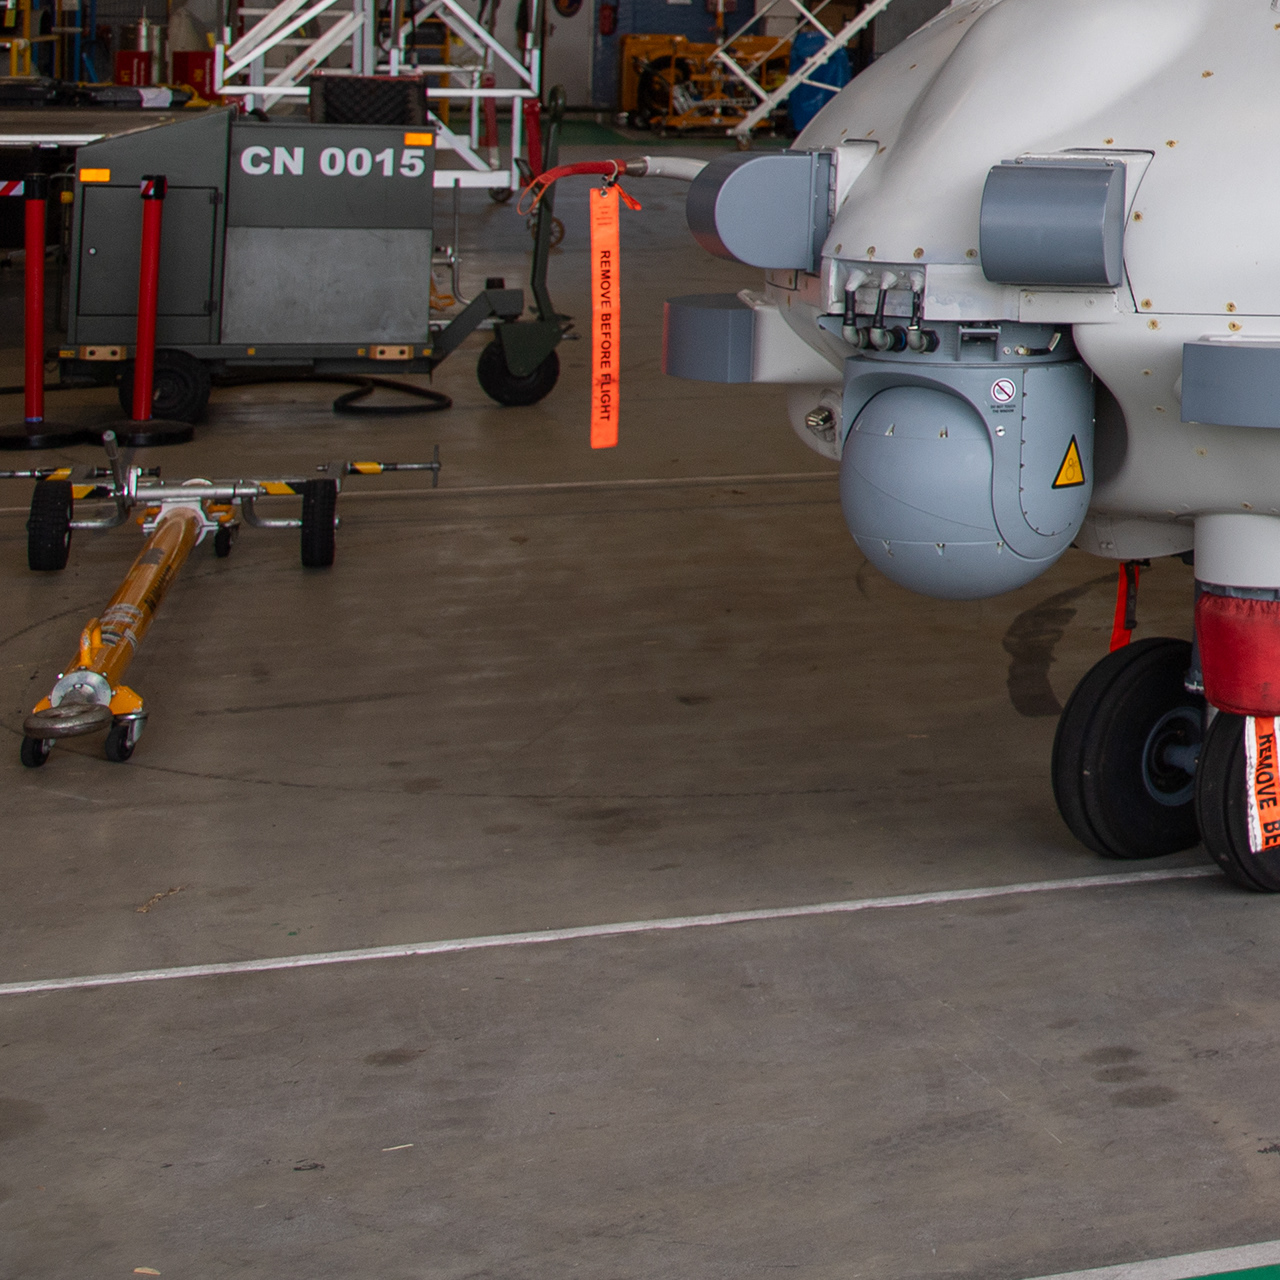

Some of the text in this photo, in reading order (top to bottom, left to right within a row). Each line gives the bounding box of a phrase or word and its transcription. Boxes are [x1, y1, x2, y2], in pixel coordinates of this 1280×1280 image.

[240, 145, 426, 178] CN 0015
[600, 250, 612, 422] REMOVE BEFORE FLIGHT
[1256, 733, 1278, 810] REMOVE
